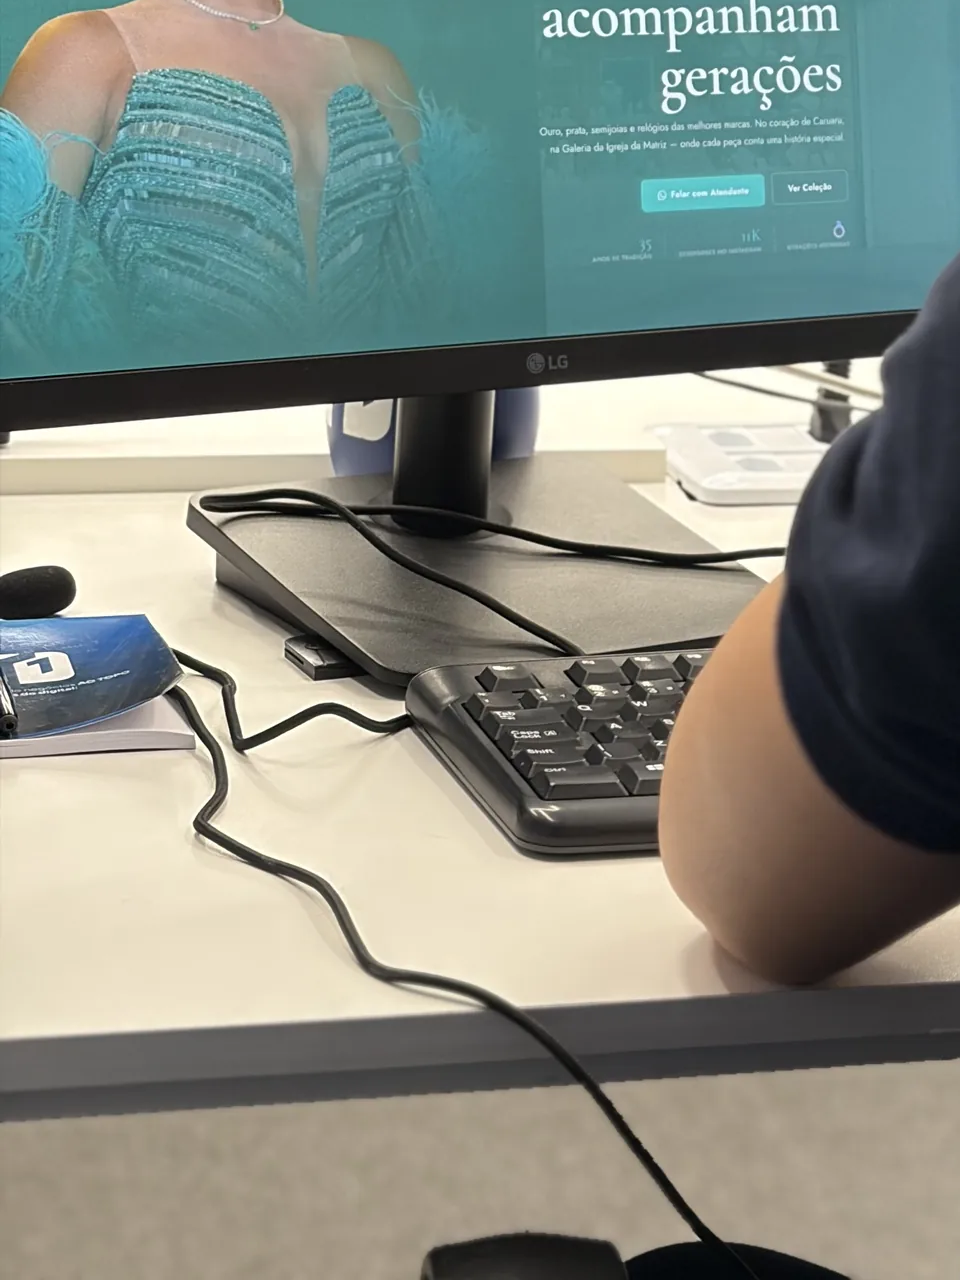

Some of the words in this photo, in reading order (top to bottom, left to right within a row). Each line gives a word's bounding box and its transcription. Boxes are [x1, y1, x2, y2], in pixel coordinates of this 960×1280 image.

[661, 55, 842, 115] gerações
[539, 127, 563, 137] Ouro,
[566, 126, 589, 137] prata,
[591, 124, 628, 135] semijoias
[637, 122, 669, 134] relógios
[671, 122, 685, 131] das
[687, 121, 722, 131] melhores
[724, 121, 752, 129] marcas.
[754, 119, 767, 128] No
[769, 118, 799, 129] coração
[801, 117, 812, 126] de
[562, 143, 592, 153] Galeria
[593, 142, 604, 151] da
[606, 142, 628, 153] Igreja
[630, 141, 641, 150] da
[643, 140, 667, 150] Matriz
[680, 138, 700, 148] onde
[702, 138, 721, 147] cada
[723, 139, 742, 148] peça
[744, 137, 764, 145] conta
[784, 134, 810, 143] história
[813, 133, 844, 143] especial.
[670, 189, 690, 199] Falar
[692, 190, 708, 198] com
[788, 184, 800, 193] Ver
[802, 182, 832, 193] Coleção
[548, 354, 568, 370] LG
[97, 670, 130, 681] TOPO
